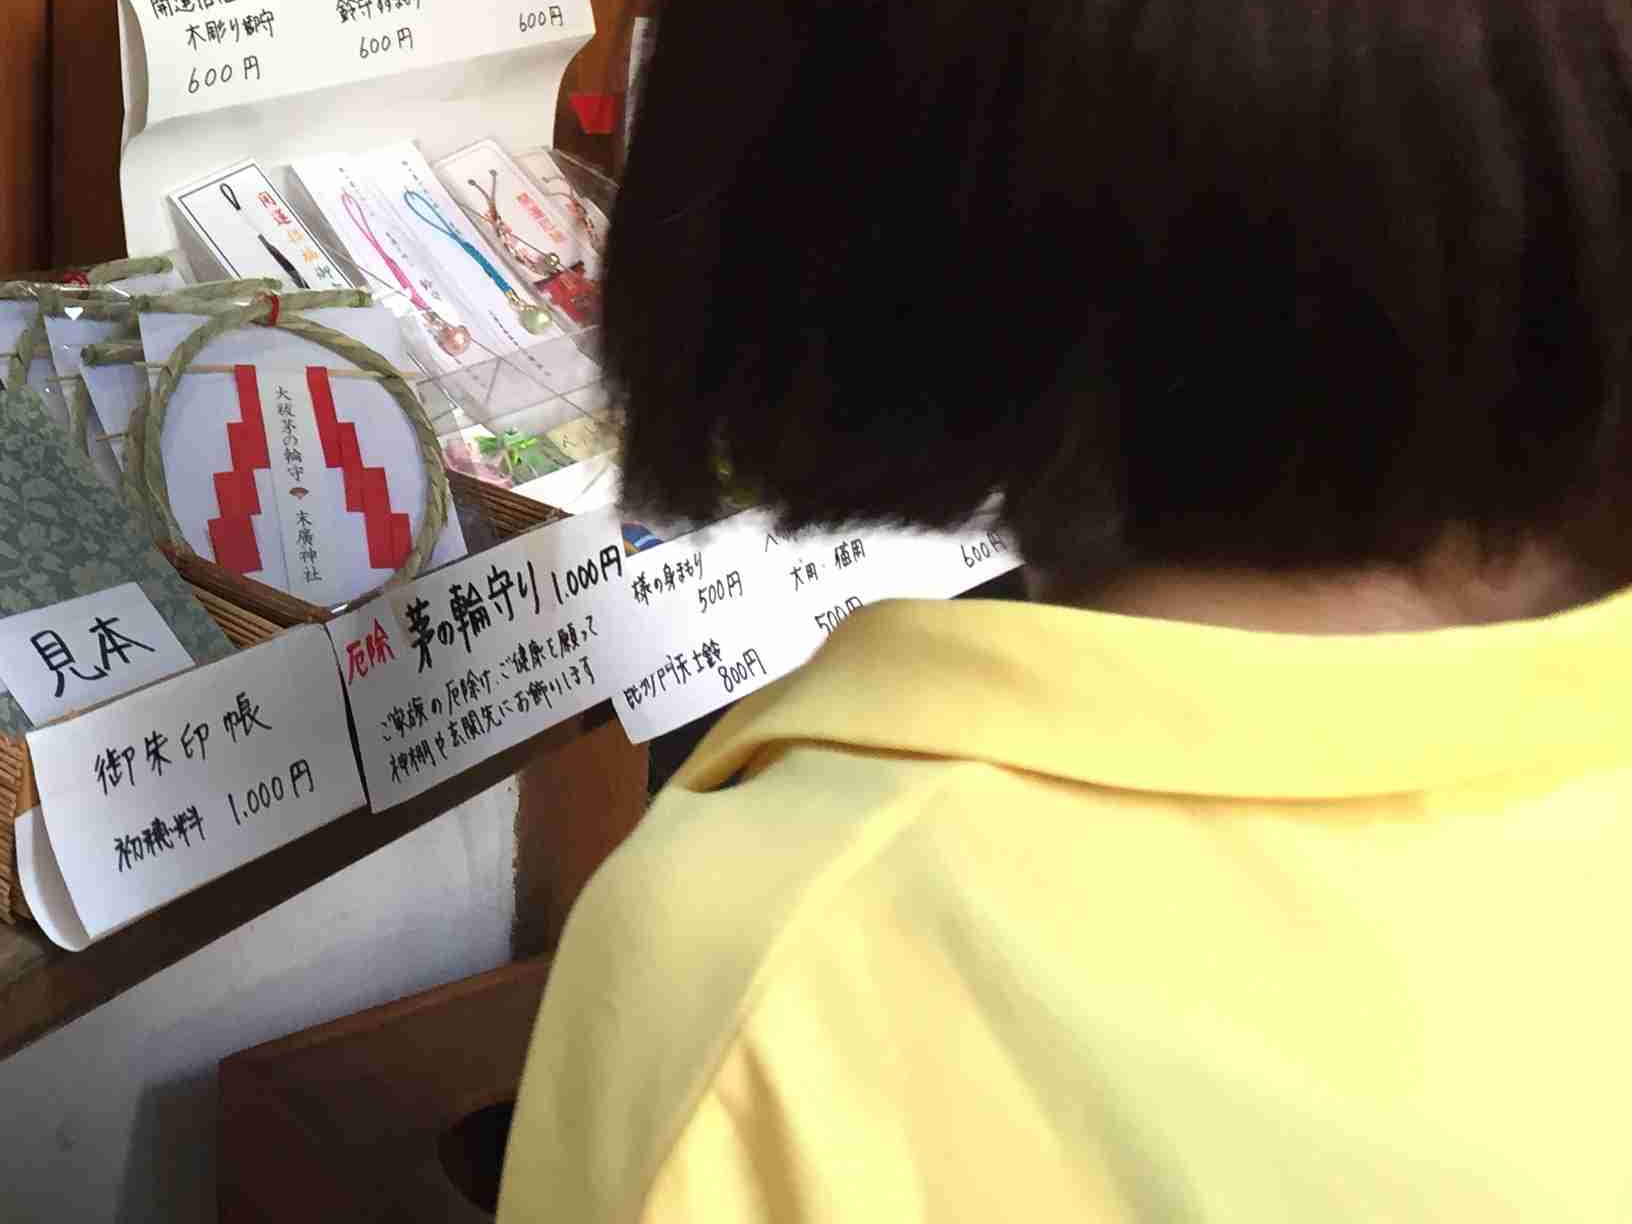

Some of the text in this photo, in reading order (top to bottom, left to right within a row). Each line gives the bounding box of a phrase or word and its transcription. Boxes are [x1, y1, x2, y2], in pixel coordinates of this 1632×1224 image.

[518, 6, 565, 33] 600円
[358, 26, 414, 61] 600円
[186, 55, 262, 95] 600円
[696, 570, 744, 614] 500円
[30, 616, 156, 699] 見本
[345, 616, 397, 687] 厄除
[717, 648, 768, 694] 800円
[93, 692, 273, 795] 御朱印帳
